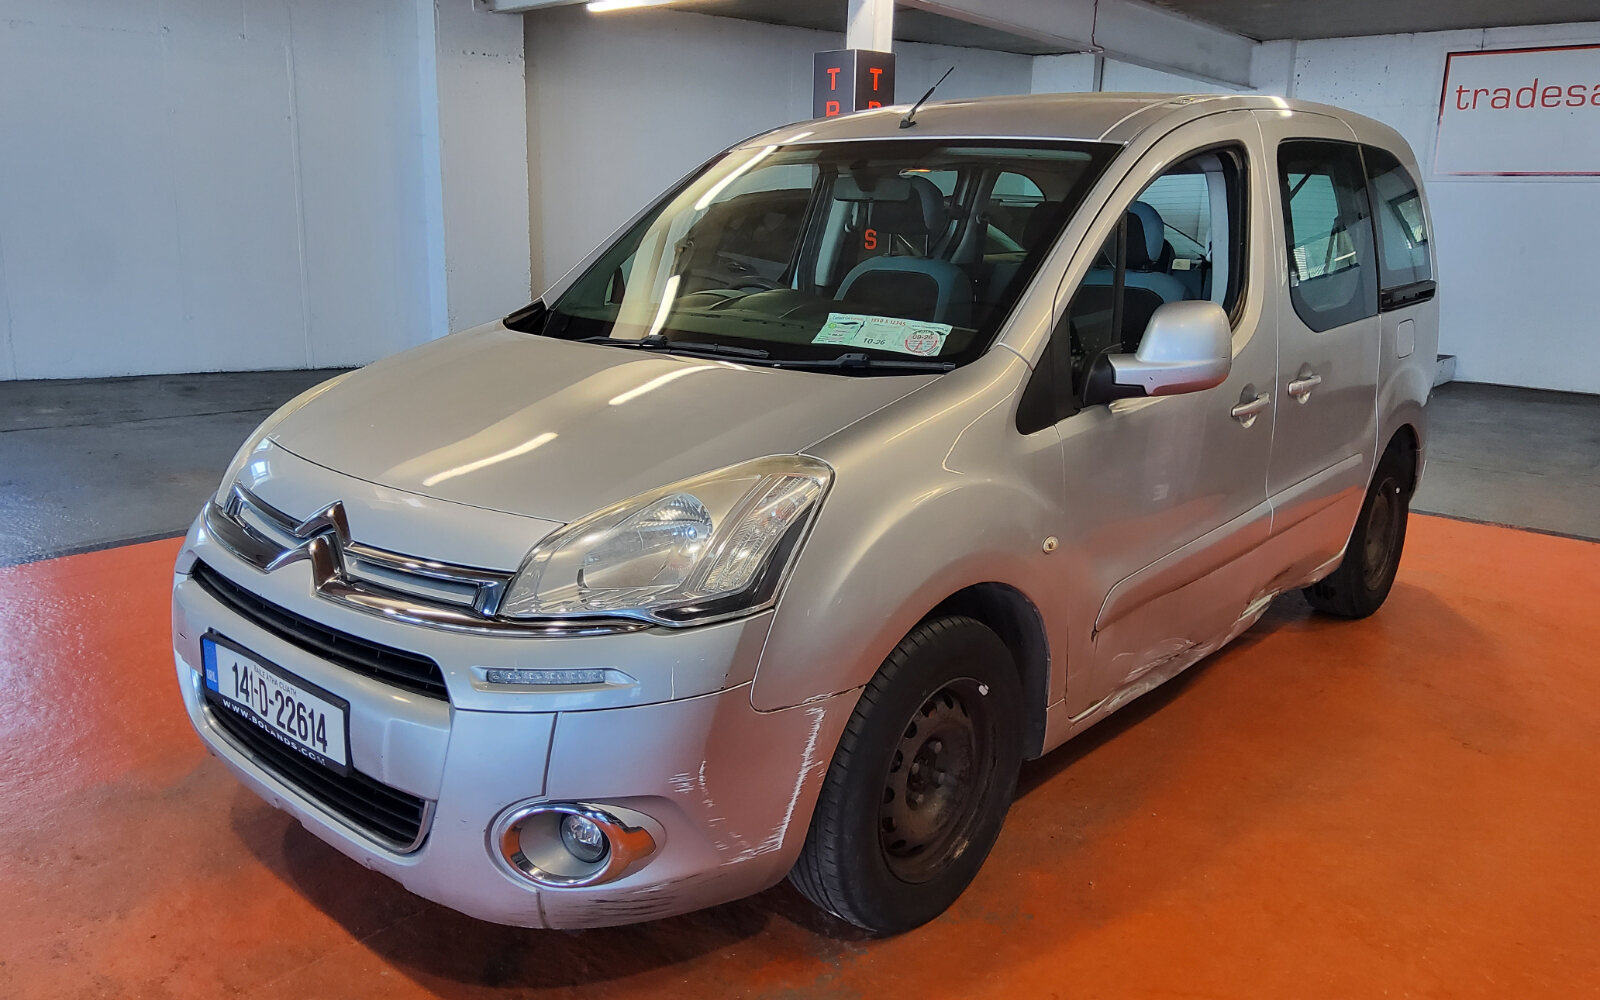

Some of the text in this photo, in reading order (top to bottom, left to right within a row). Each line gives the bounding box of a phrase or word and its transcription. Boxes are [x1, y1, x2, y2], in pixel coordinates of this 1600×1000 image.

[864, 229, 877, 250] S
[863, 337, 886, 346] 10-26
[232, 661, 328, 753] 141-D-22614
[222, 698, 326, 767] WWW.BOLANDS.COM
